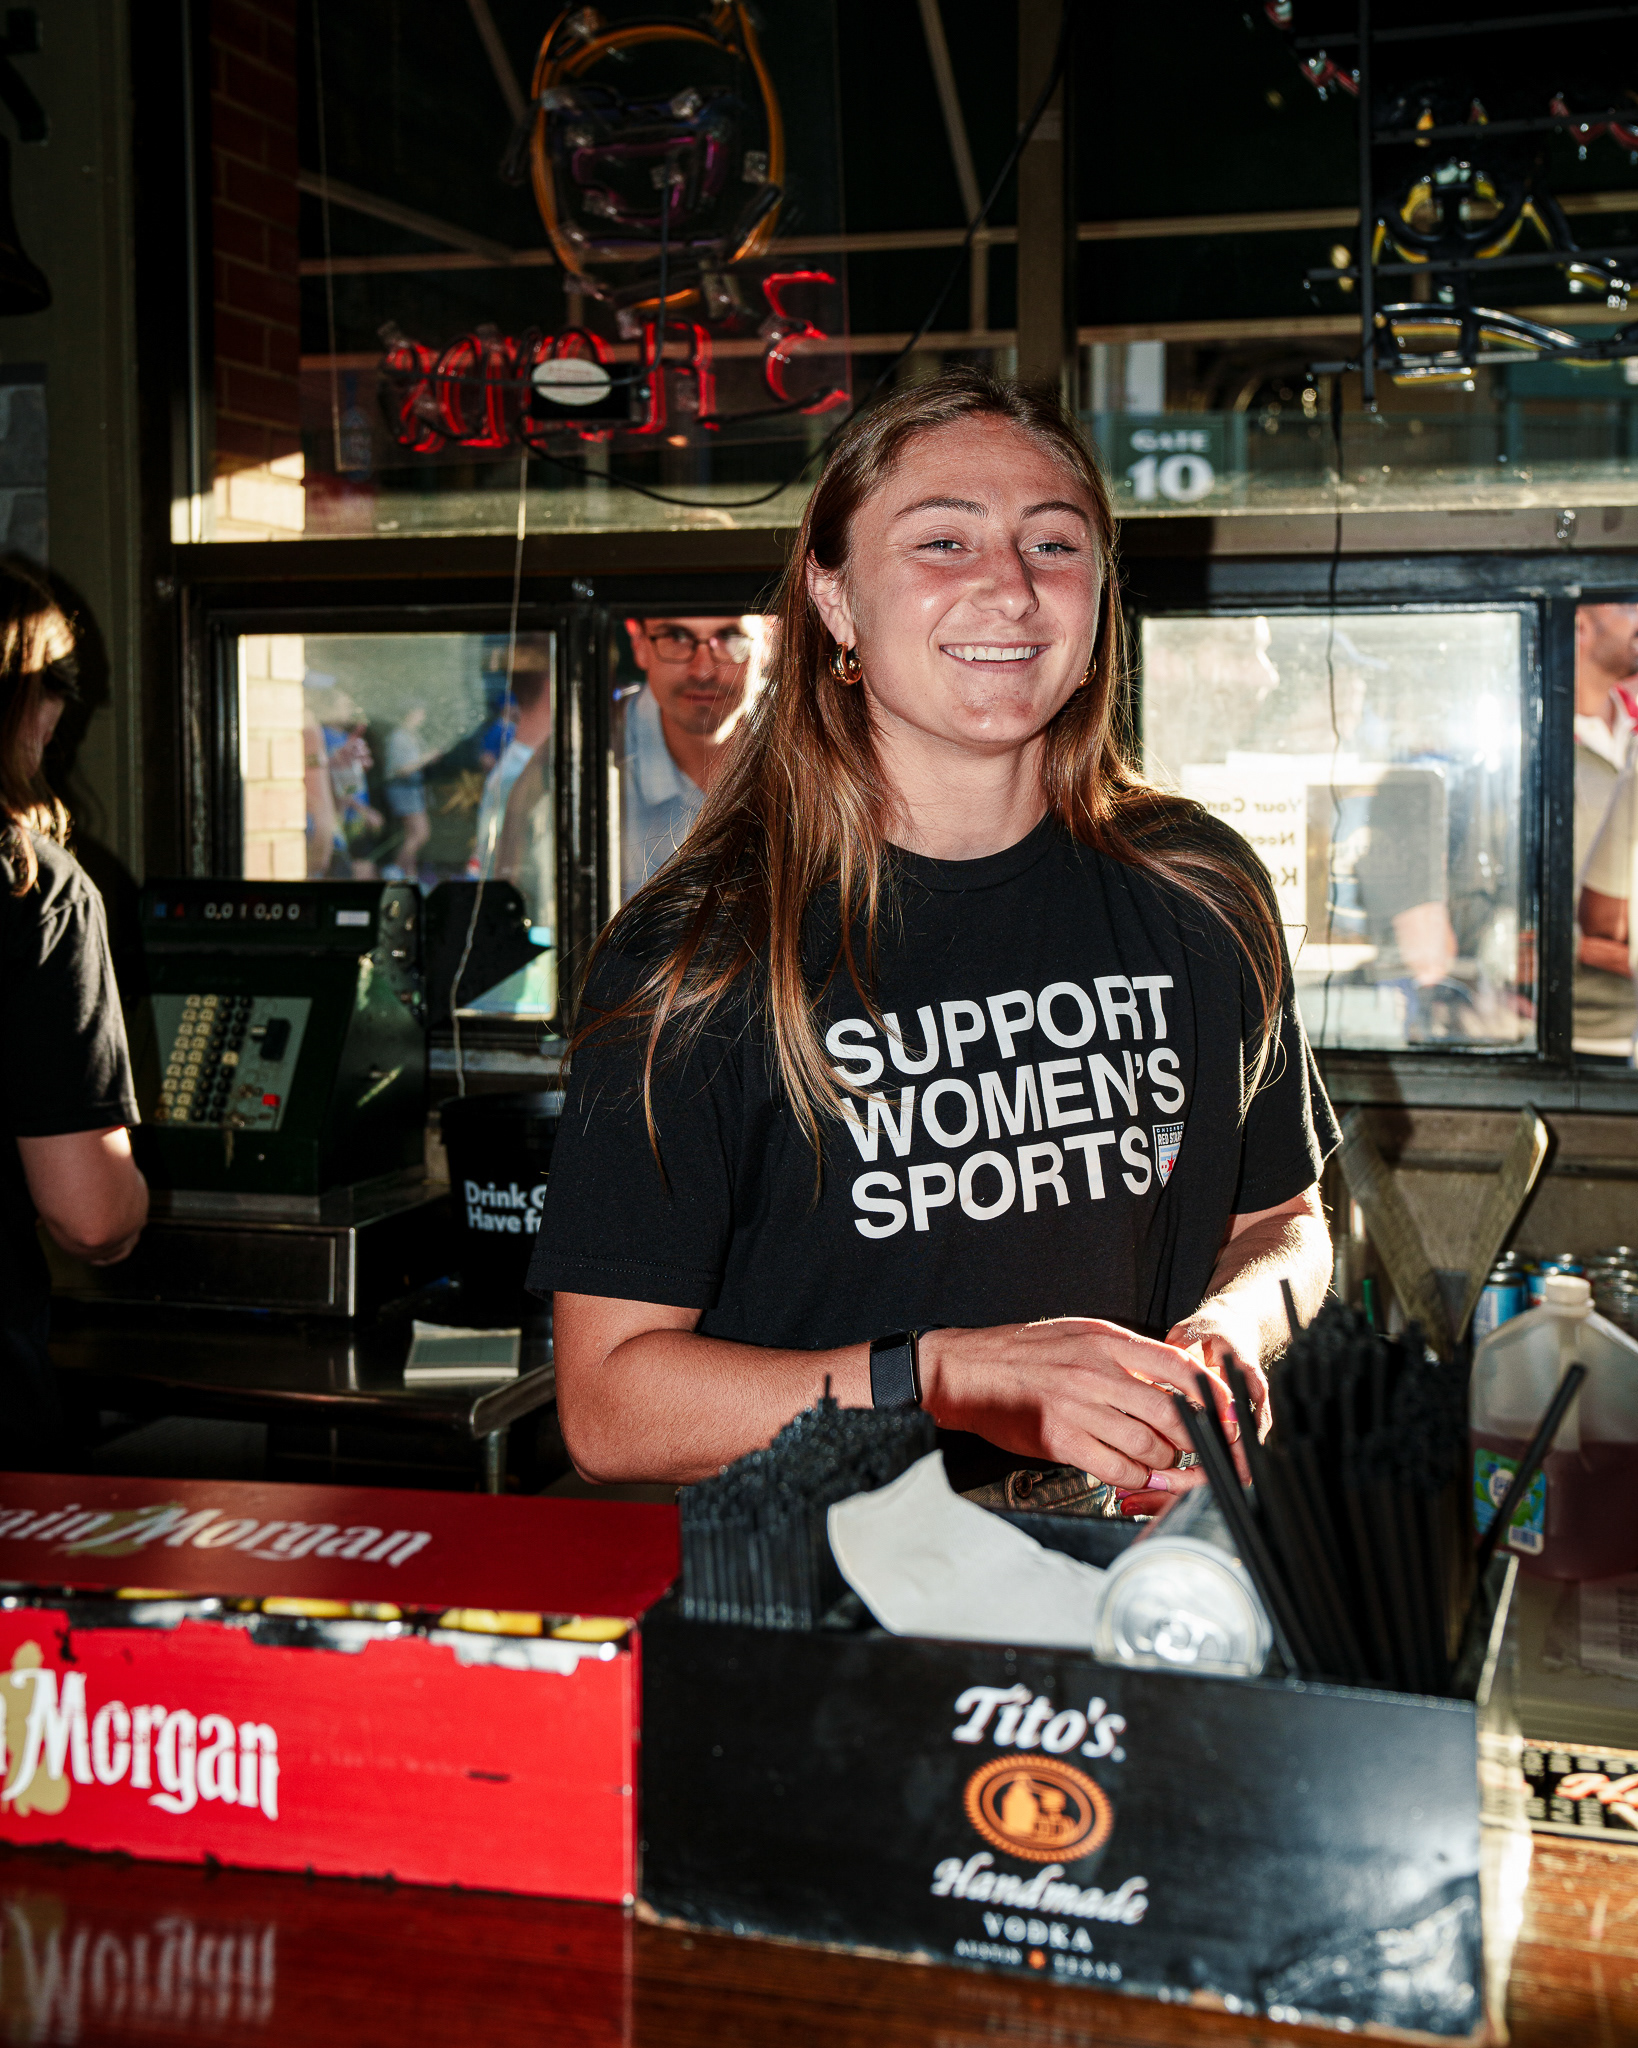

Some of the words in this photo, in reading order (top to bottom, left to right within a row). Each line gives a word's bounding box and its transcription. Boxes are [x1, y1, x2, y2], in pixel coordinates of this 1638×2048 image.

[1130, 429, 1211, 453] GATE
[1126, 453, 1215, 503] 10
[825, 974, 1174, 1087] SUPPORT
[839, 1047, 1186, 1163] WOMEN'S
[1157, 1132, 1170, 1146] RED
[464, 1179, 528, 1210] Drink
[851, 1125, 1152, 1239] SPORTS
[467, 1203, 522, 1234] Have
[52, 1504, 432, 1567] Morgan
[0, 1667, 280, 1822] Morgan
[952, 1682, 1127, 1760] Tito's
[930, 1851, 1149, 1926] Handmade
[982, 1911, 1094, 1954] VODKA
